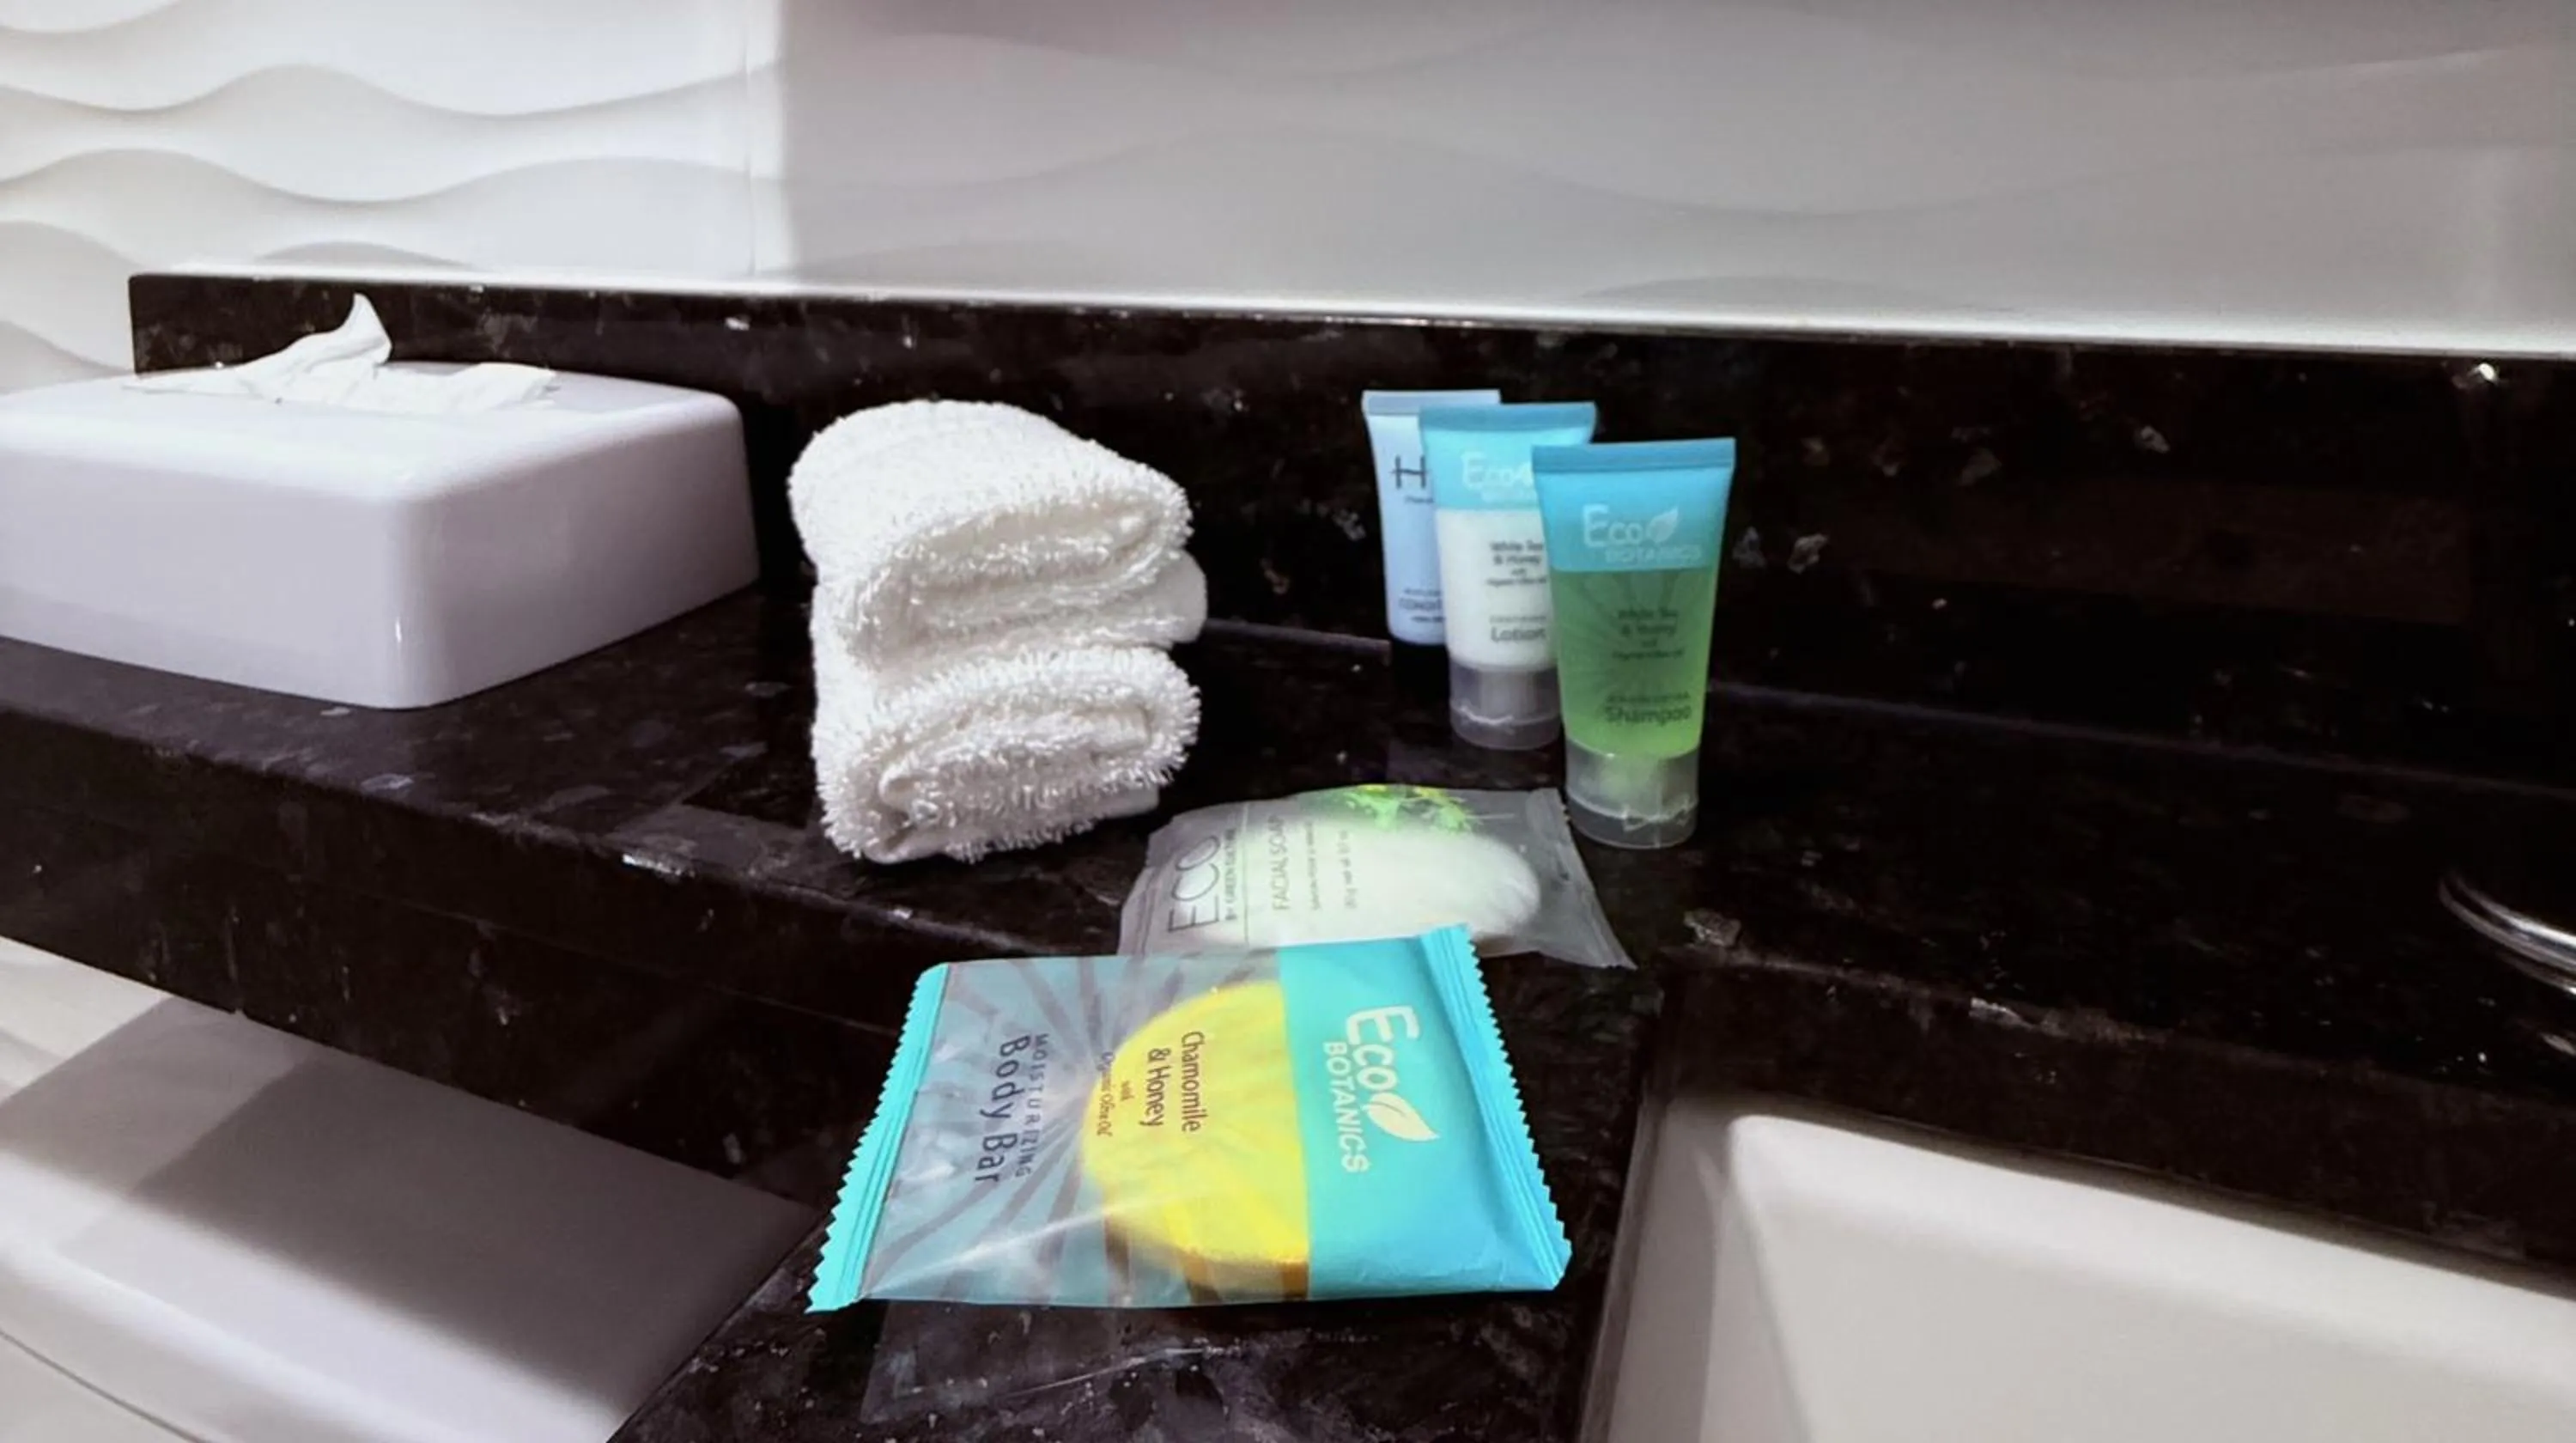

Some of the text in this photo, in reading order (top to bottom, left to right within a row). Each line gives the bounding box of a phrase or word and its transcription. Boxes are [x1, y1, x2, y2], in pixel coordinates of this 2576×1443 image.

[1461, 452, 1516, 491] Eco
[1583, 502, 1644, 548] Eco
[1491, 625, 1546, 643] Lotion
[1604, 704, 1692, 728] Shampoo
[1168, 836, 1219, 933] ECO
[1267, 814, 1291, 911] FACIAL SOAP
[1139, 1047, 1172, 1128] & Honey
[1181, 1030, 1208, 1133] Chamomile
[1345, 1005, 1420, 1091] Eco
[974, 1035, 1031, 1184] Body Bar
[1014, 1032, 1049, 1179] MOISTURIZING
[1322, 1040, 1369, 1174] BOTANICS
